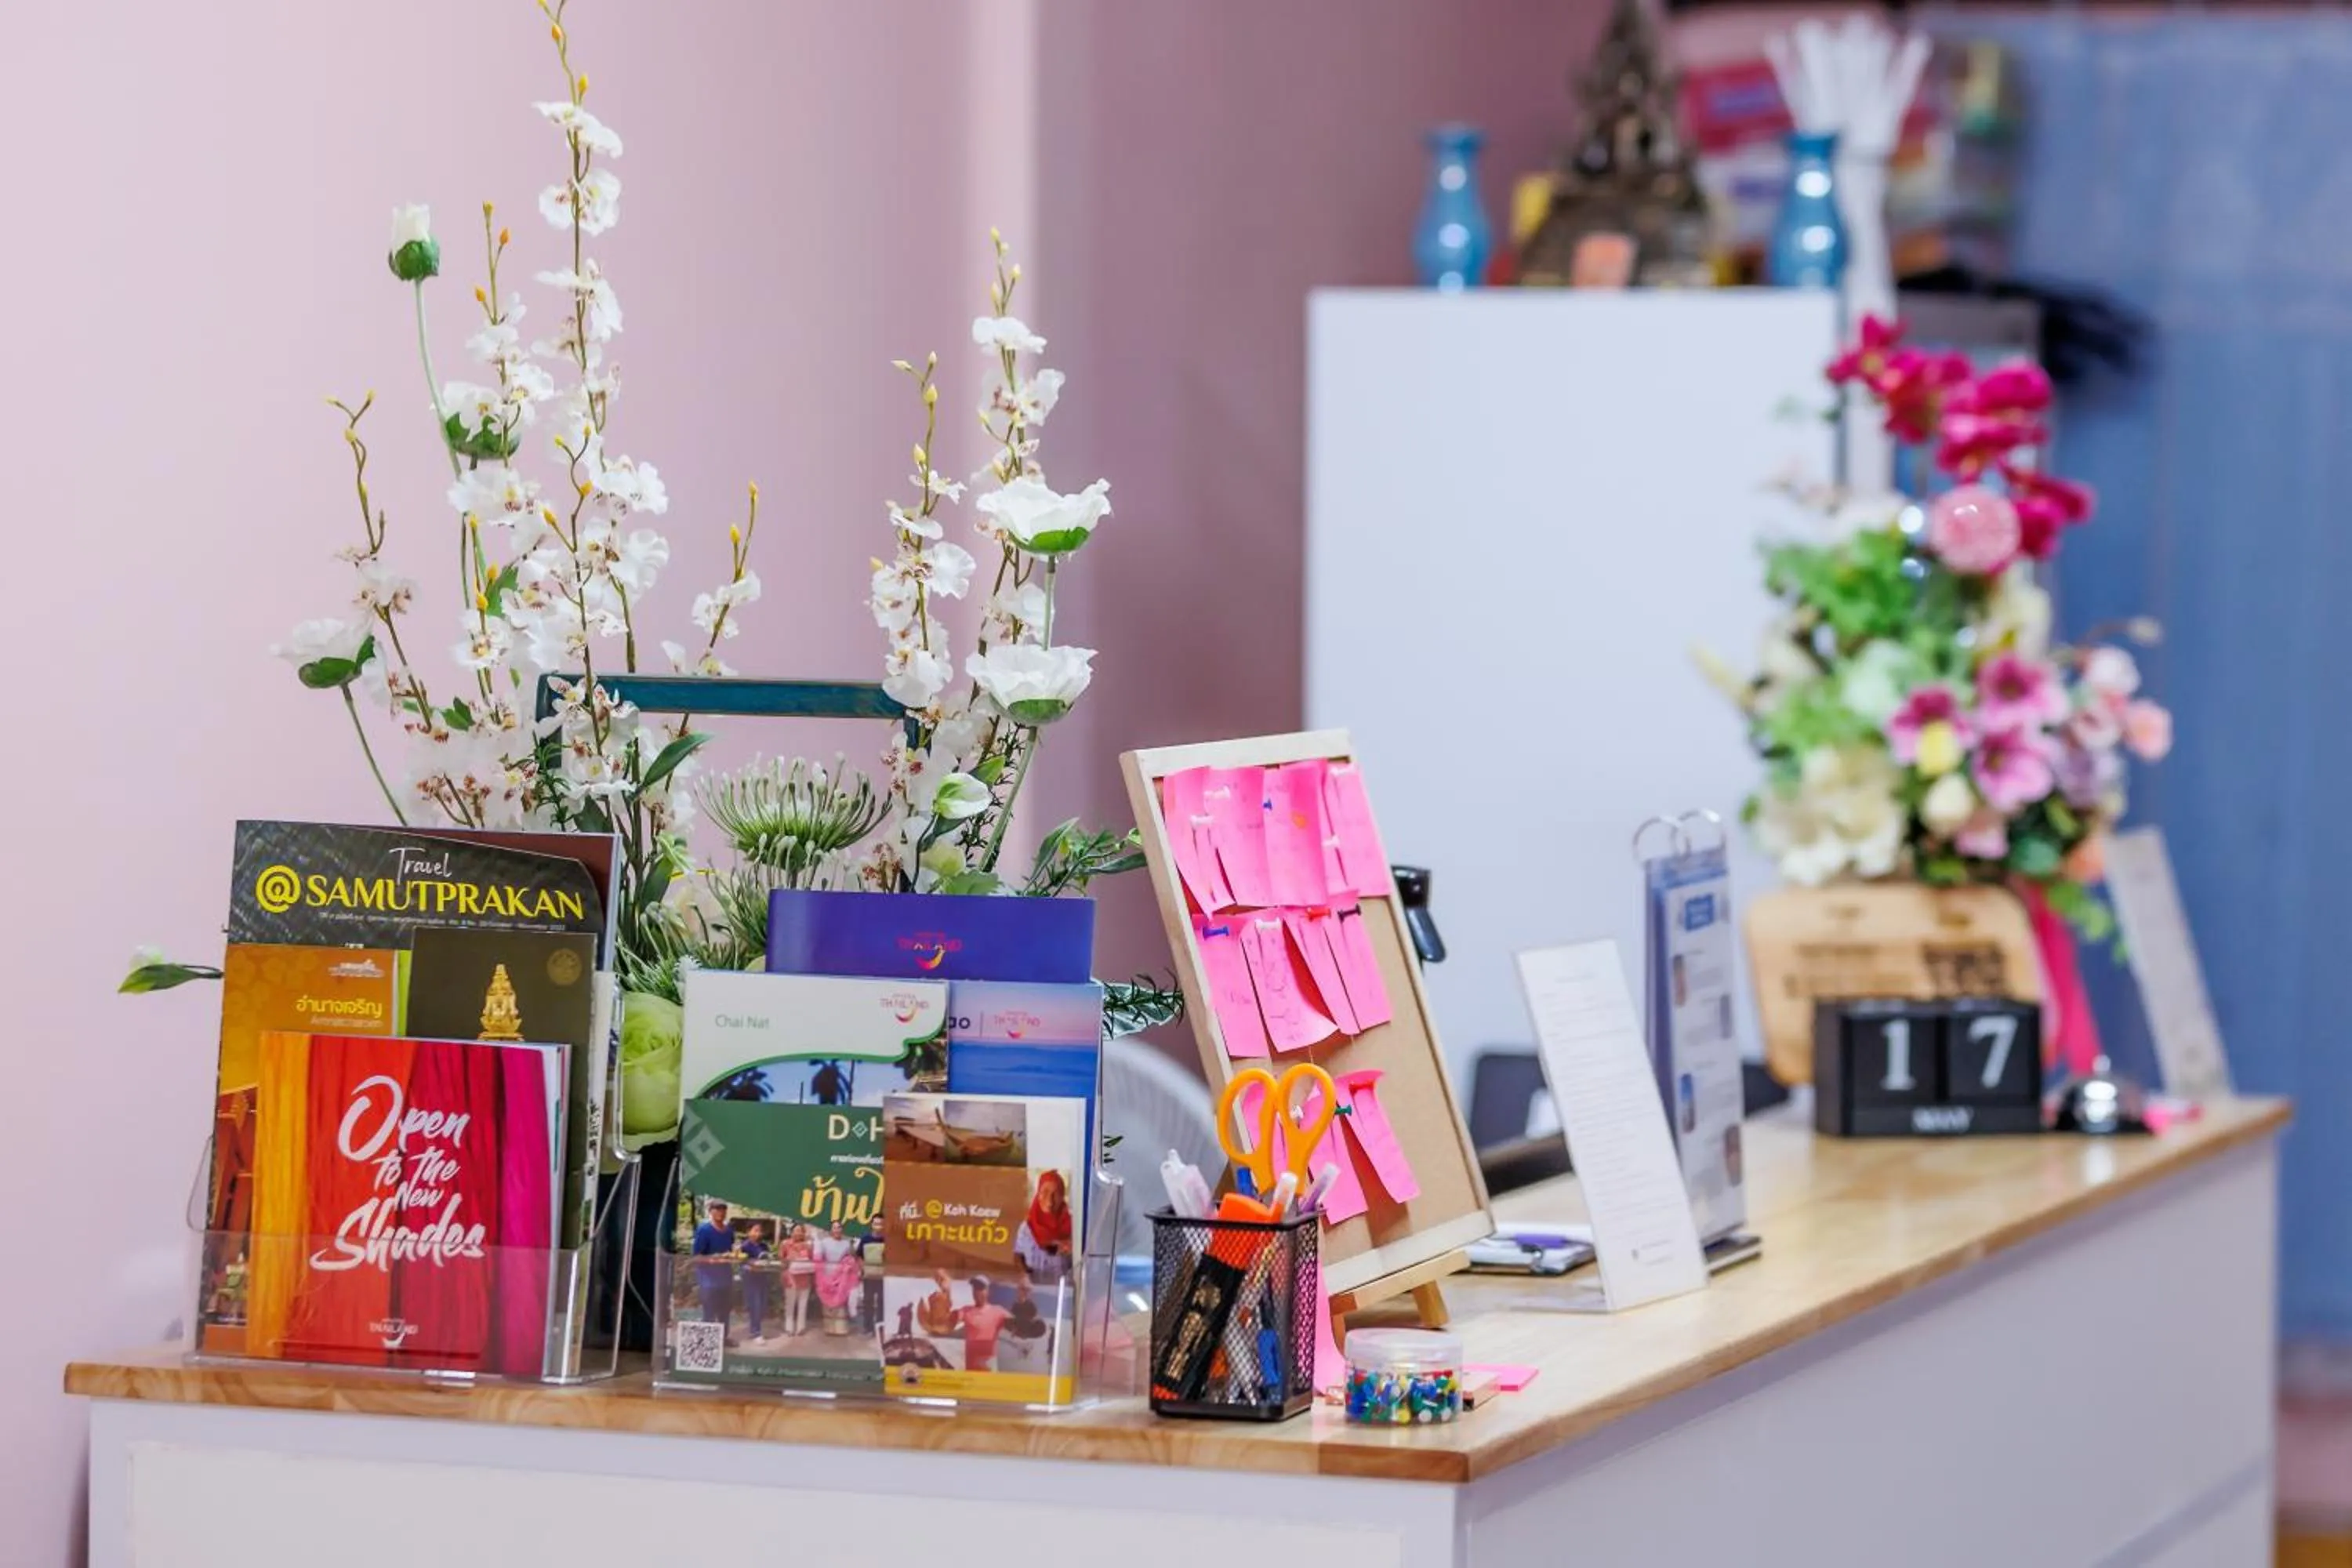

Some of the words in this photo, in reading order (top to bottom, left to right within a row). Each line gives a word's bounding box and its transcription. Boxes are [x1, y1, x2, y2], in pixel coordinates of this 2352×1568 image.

[389, 847, 452, 885] Travel
[714, 1014, 744, 1029] Chai
[747, 1016, 770, 1029] Nat
[337, 1075, 471, 1162] Open
[394, 1181, 445, 1211] New
[310, 1193, 486, 1272] Shades
